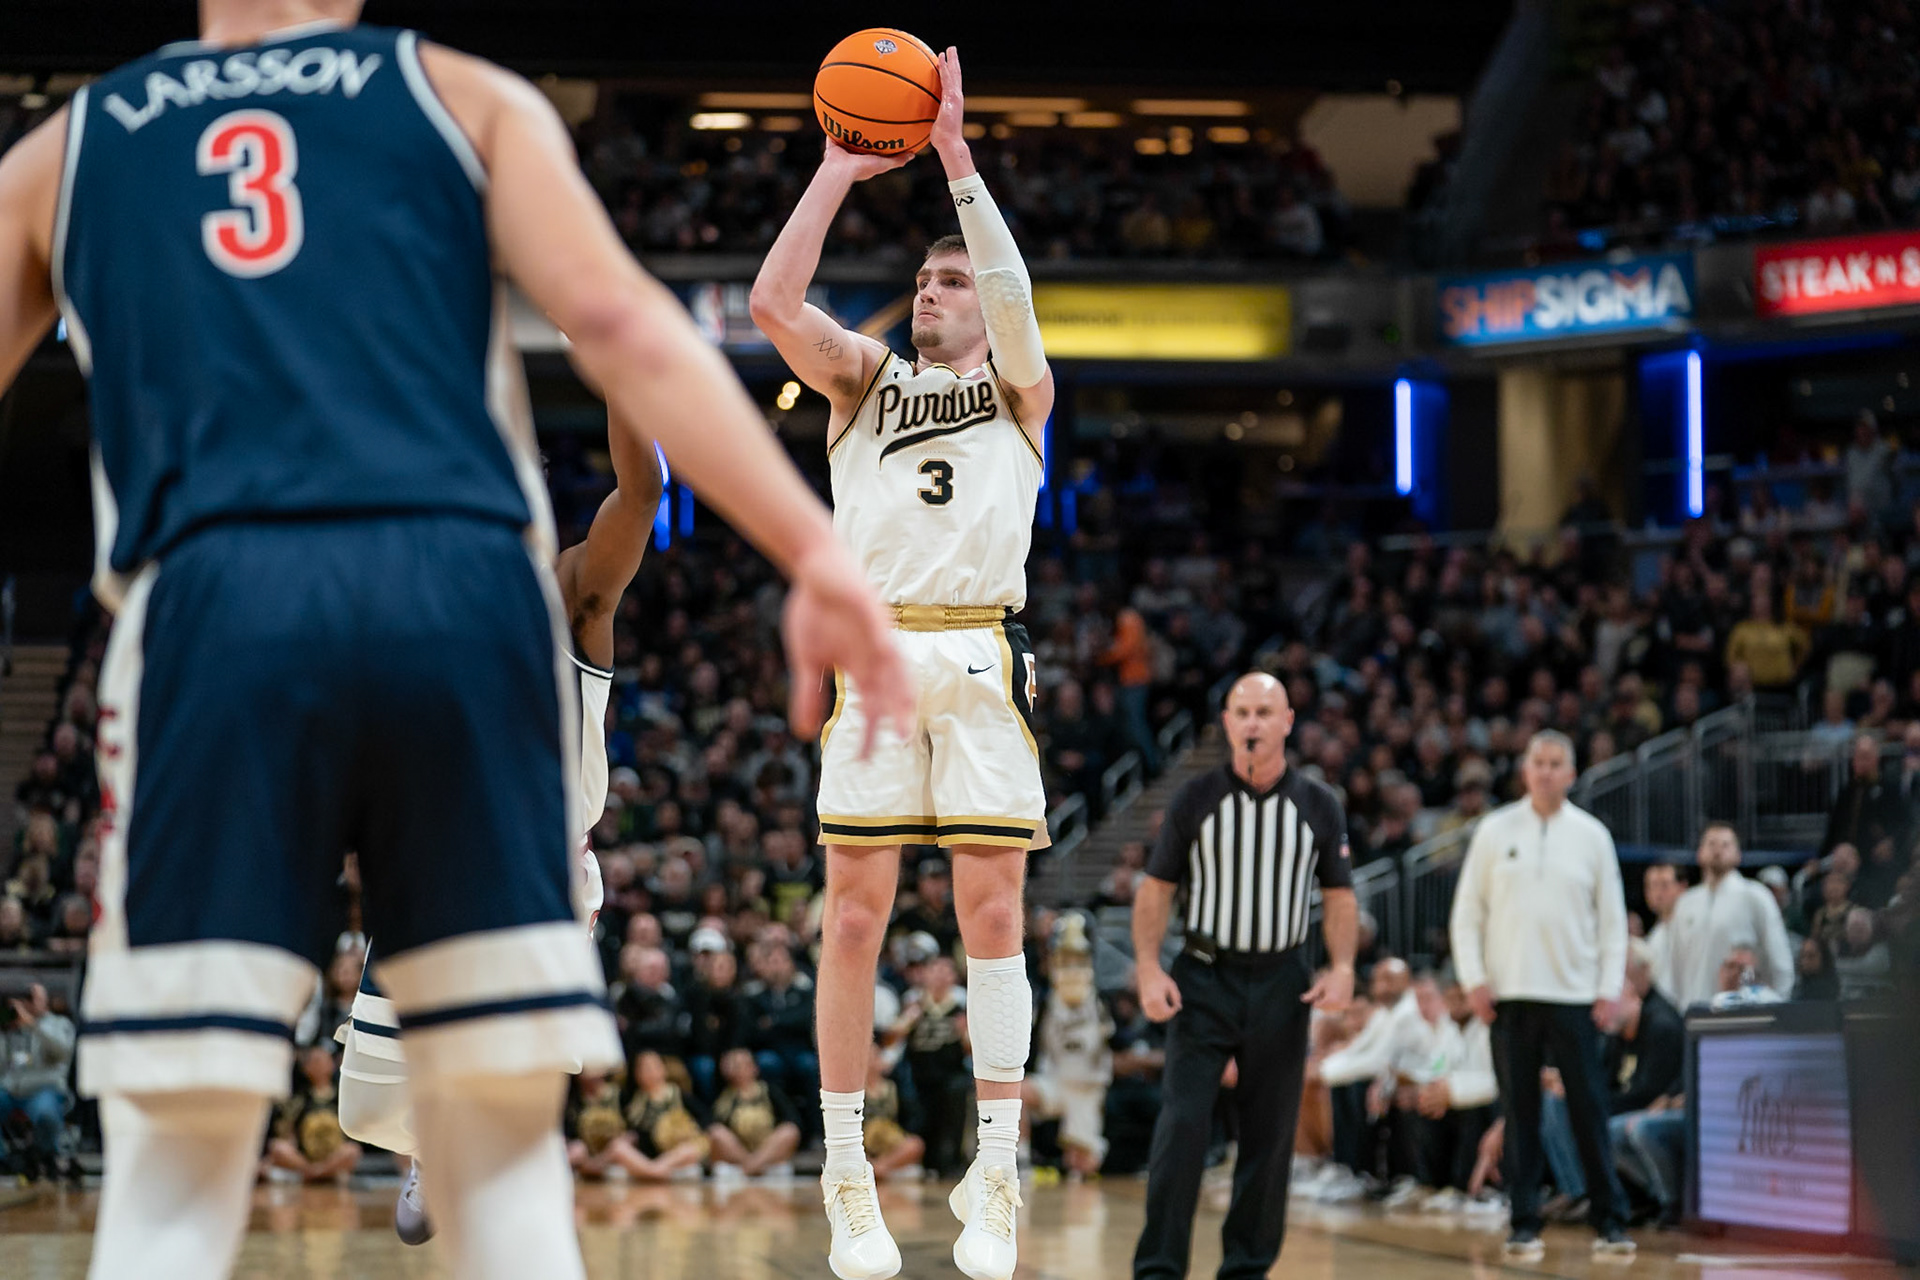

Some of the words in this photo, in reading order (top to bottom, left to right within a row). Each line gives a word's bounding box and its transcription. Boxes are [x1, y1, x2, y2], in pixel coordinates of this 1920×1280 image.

[102, 46, 383, 134] LARSSON
[822, 110, 905, 150] Wilson
[195, 107, 305, 280] 3
[1761, 251, 1874, 302] STEAK
[875, 381, 998, 438] Purdue
[917, 458, 954, 506] 3
